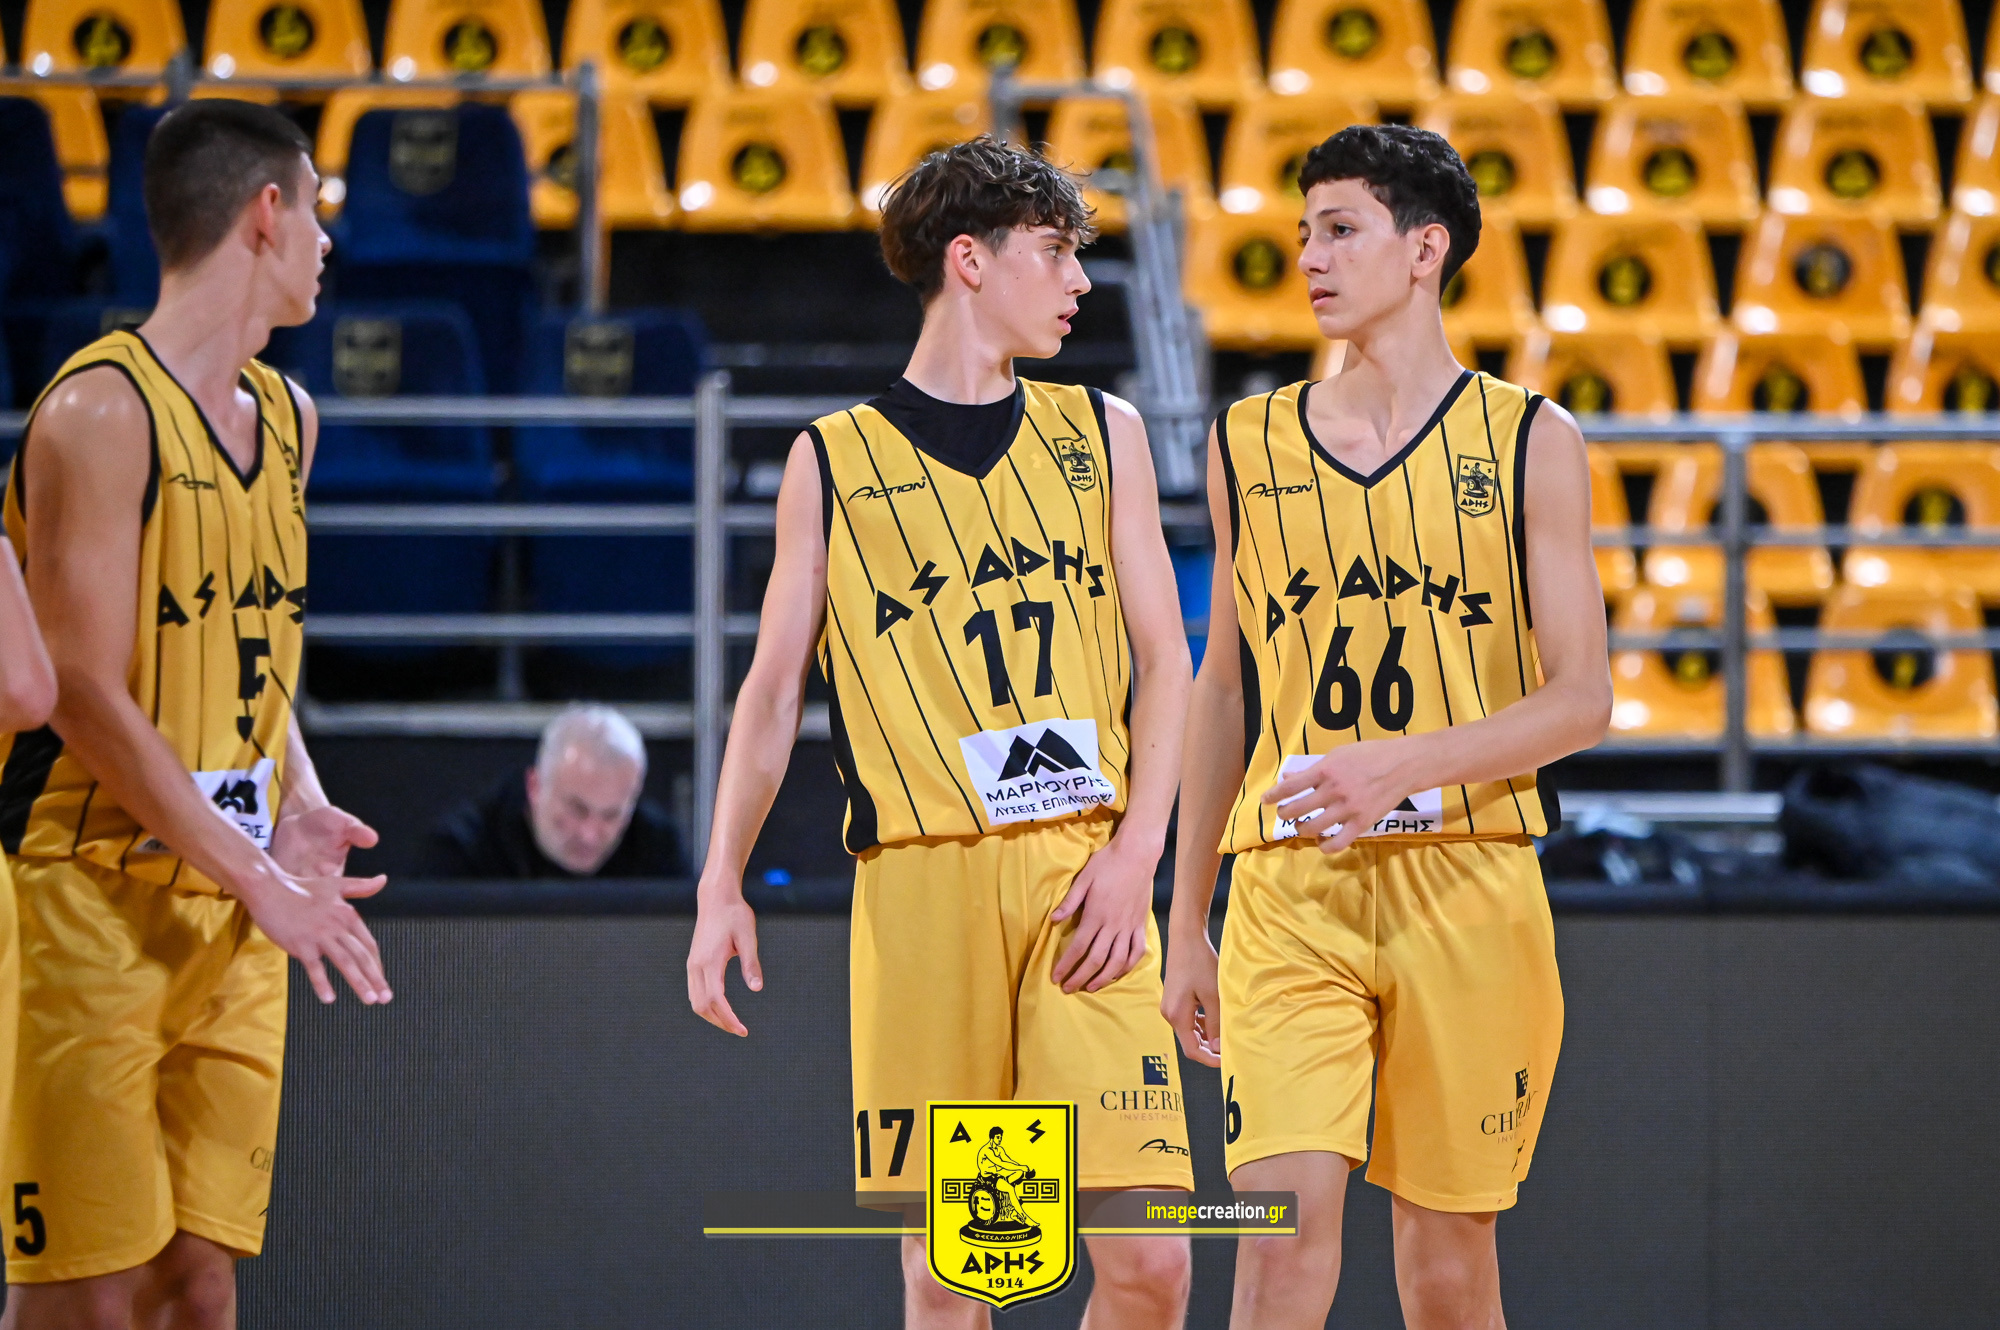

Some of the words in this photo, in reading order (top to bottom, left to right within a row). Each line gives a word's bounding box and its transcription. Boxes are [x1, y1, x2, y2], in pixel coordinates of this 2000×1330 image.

[847, 481, 926, 504] ACTION
[1245, 483, 1313, 500] ACTION
[963, 600, 1055, 707] 17
[1312, 626, 1414, 732] 66
[995, 803, 1039, 817] ΛΥΣΕΙΣ
[1100, 1090, 1183, 1112] CHERR
[856, 1108, 914, 1178] 17
[1138, 1139, 1189, 1156] ACTIO
[14, 1182, 46, 1256] 5
